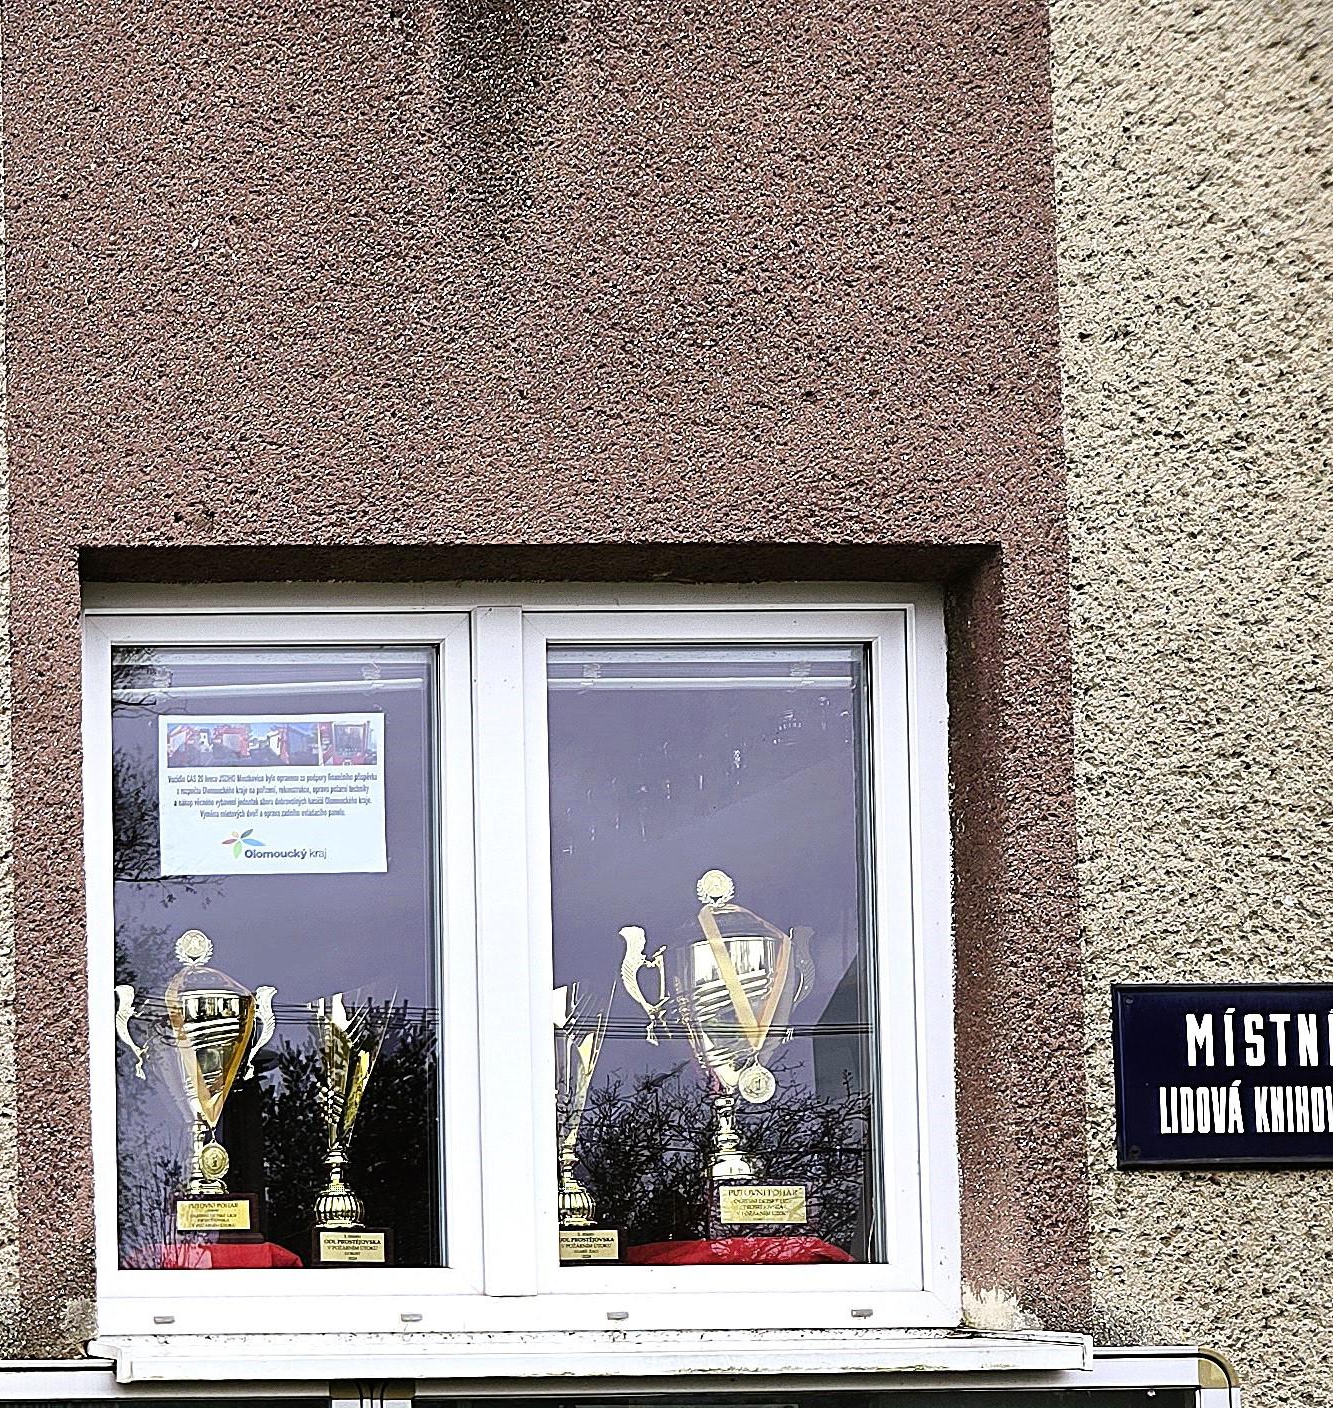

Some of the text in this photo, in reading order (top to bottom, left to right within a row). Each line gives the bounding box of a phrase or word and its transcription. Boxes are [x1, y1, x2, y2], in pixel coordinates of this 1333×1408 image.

[245, 849, 326, 859] Olomoucký kraj
[1160, 1080, 1244, 1133] LIDOVÁ
